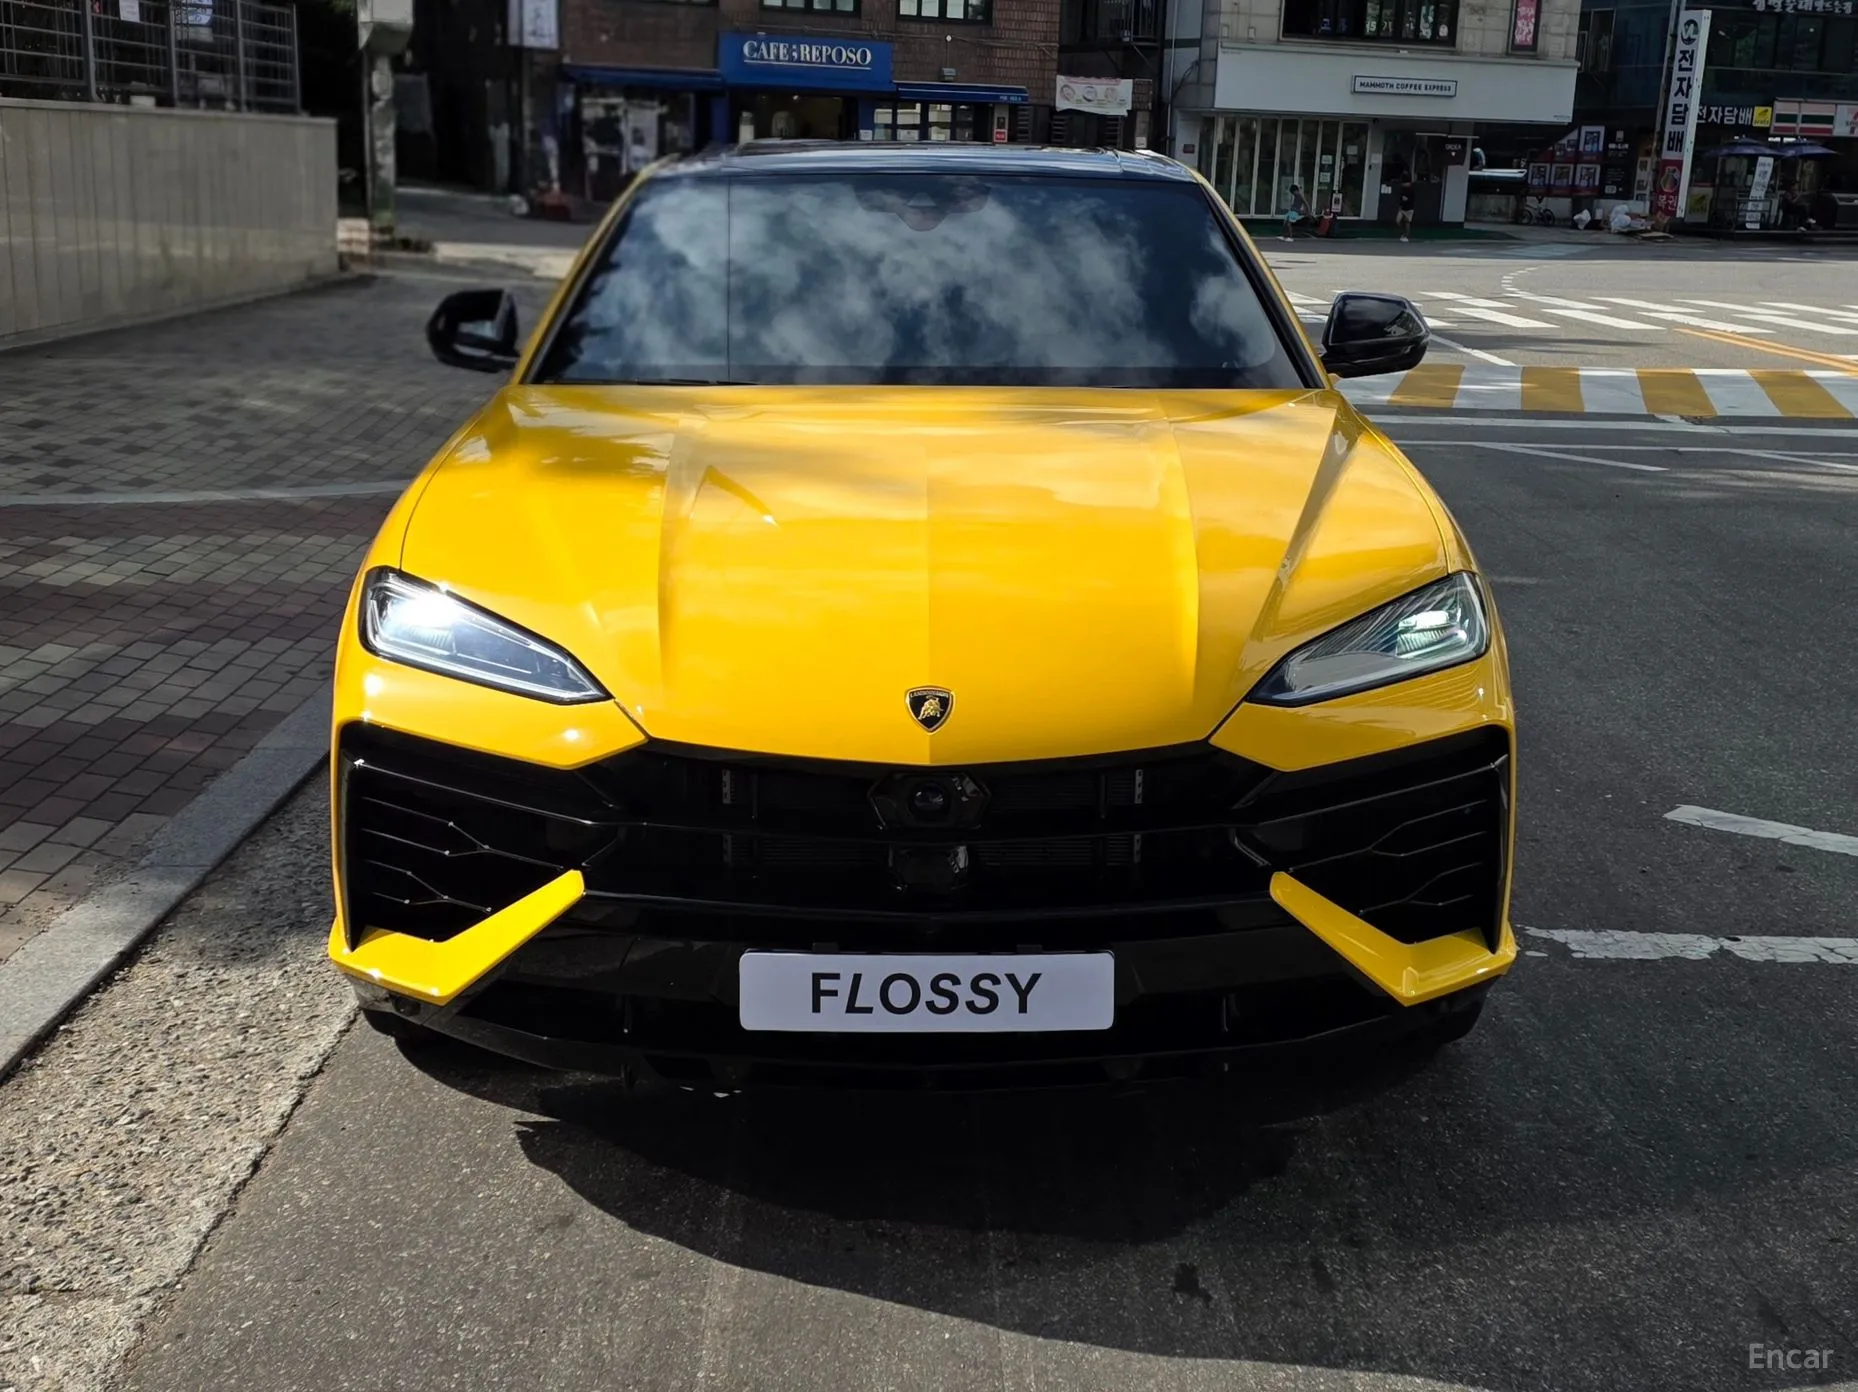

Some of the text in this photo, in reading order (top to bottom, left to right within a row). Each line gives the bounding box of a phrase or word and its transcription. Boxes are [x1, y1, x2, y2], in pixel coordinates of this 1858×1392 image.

[1360, 81, 1451, 92] MAMMOTH COFFEE EXPRESS
[1667, 49, 1695, 153] 전자담배
[811, 972, 1043, 1015] FLOSSY
